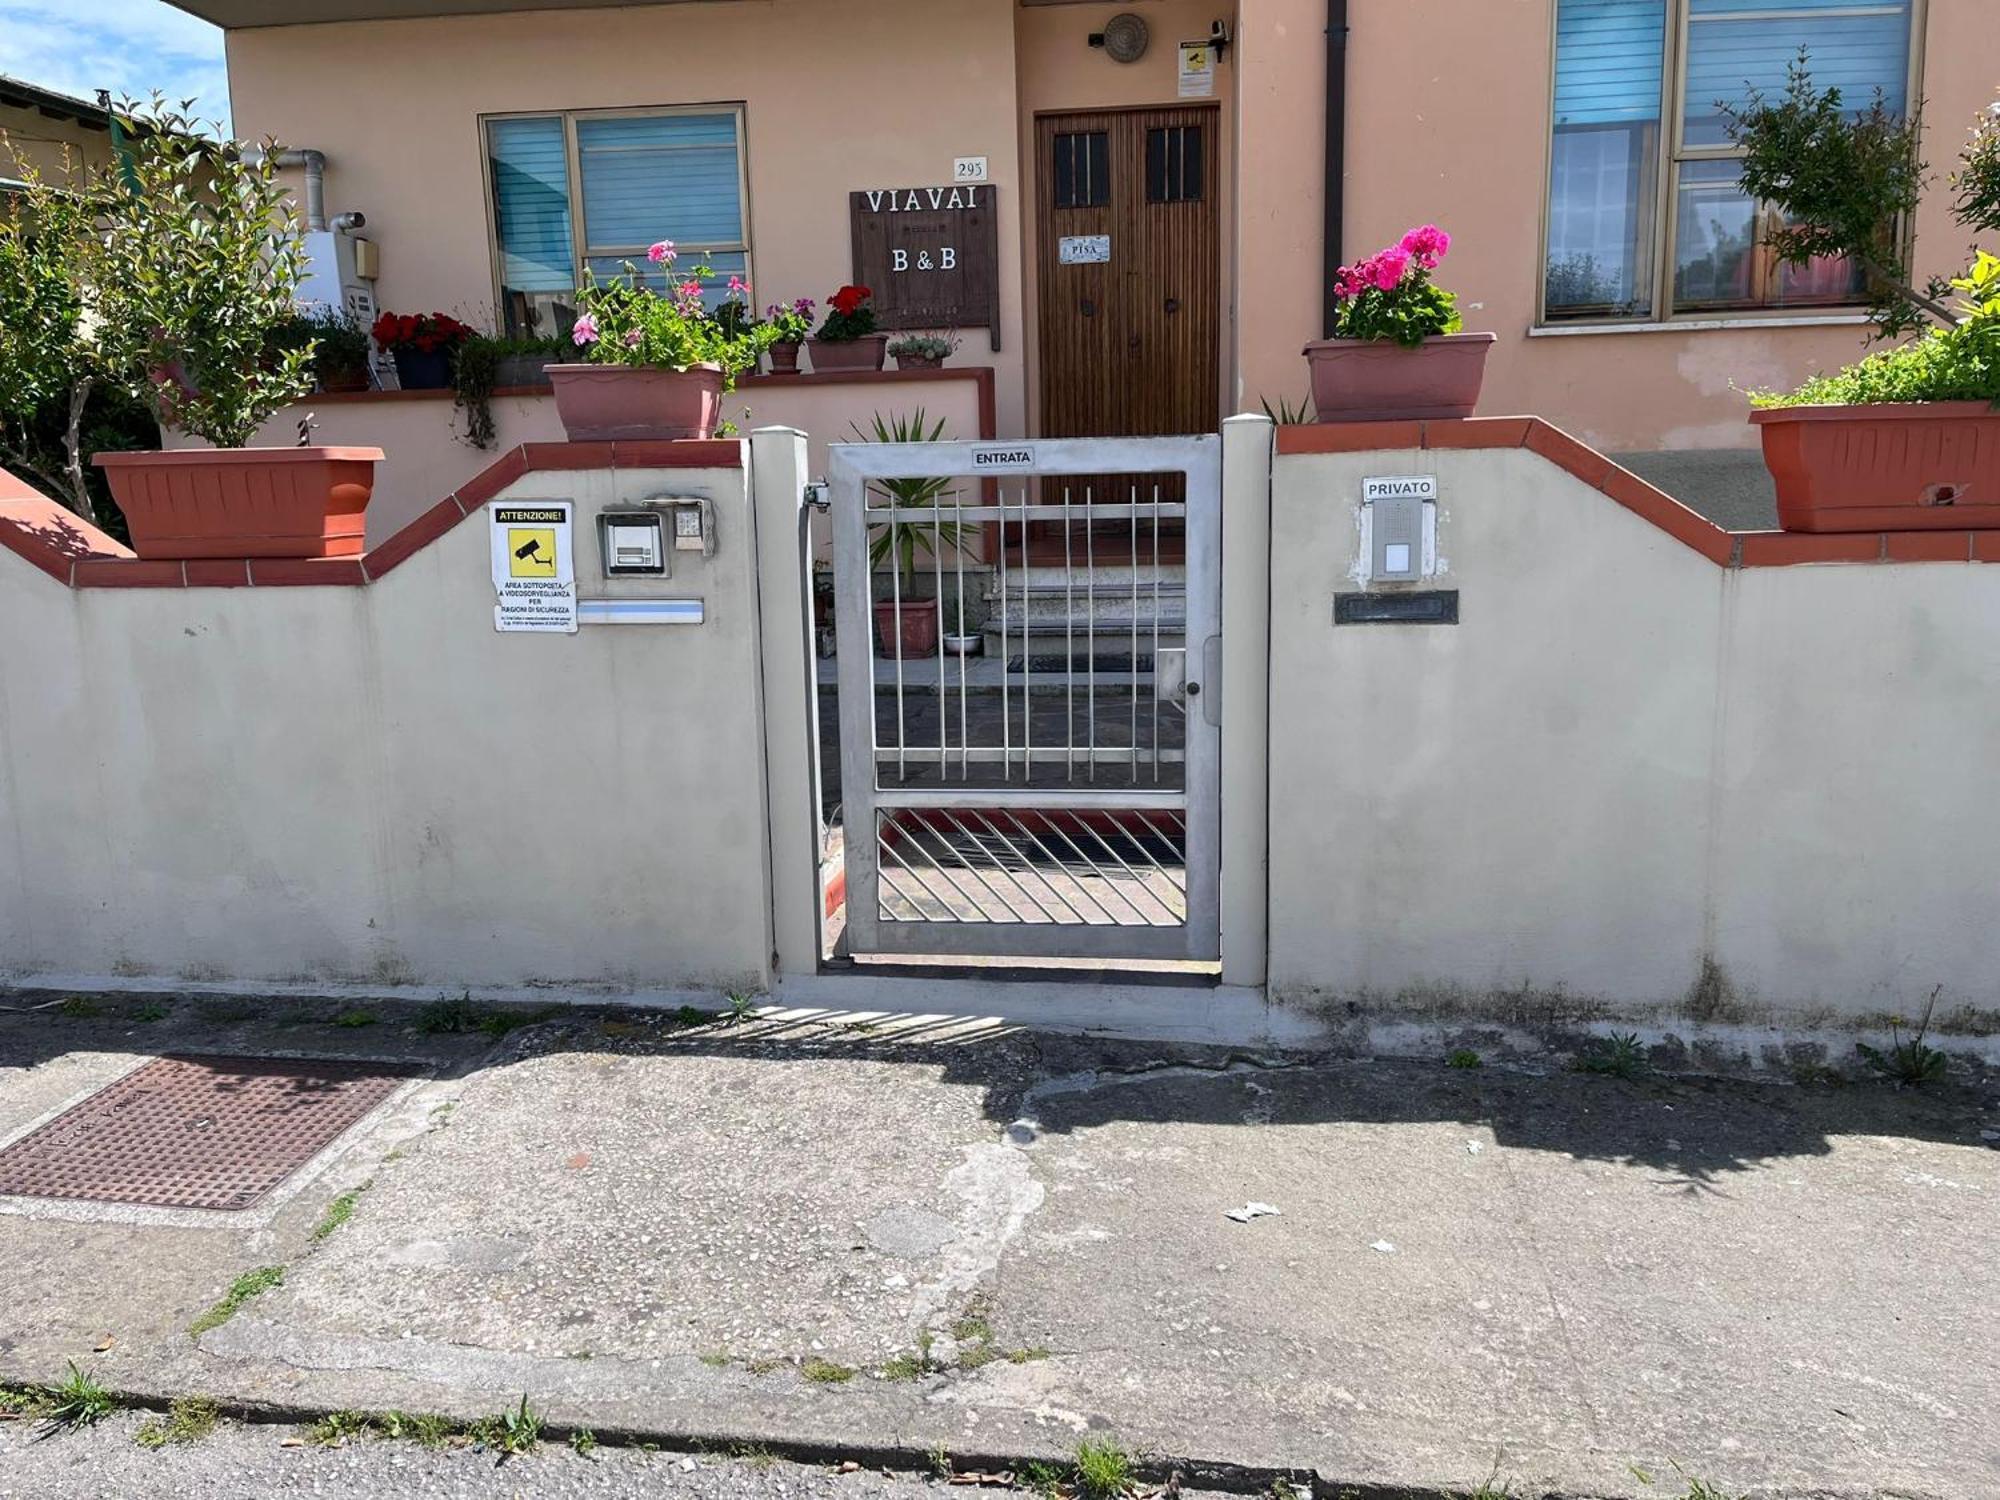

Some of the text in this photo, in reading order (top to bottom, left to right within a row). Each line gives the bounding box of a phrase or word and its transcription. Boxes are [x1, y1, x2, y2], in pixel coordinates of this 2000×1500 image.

[958, 162, 983, 177] 295
[865, 186, 977, 213] VIAVAI
[1072, 245, 1097, 254] PISA
[892, 247, 956, 272] B & B
[976, 452, 1031, 464] ENTRATA
[1368, 482, 1431, 495] PRIVATO
[499, 511, 562, 521] ATTENZIONE!
[535, 606, 569, 614] SICUREZZA
